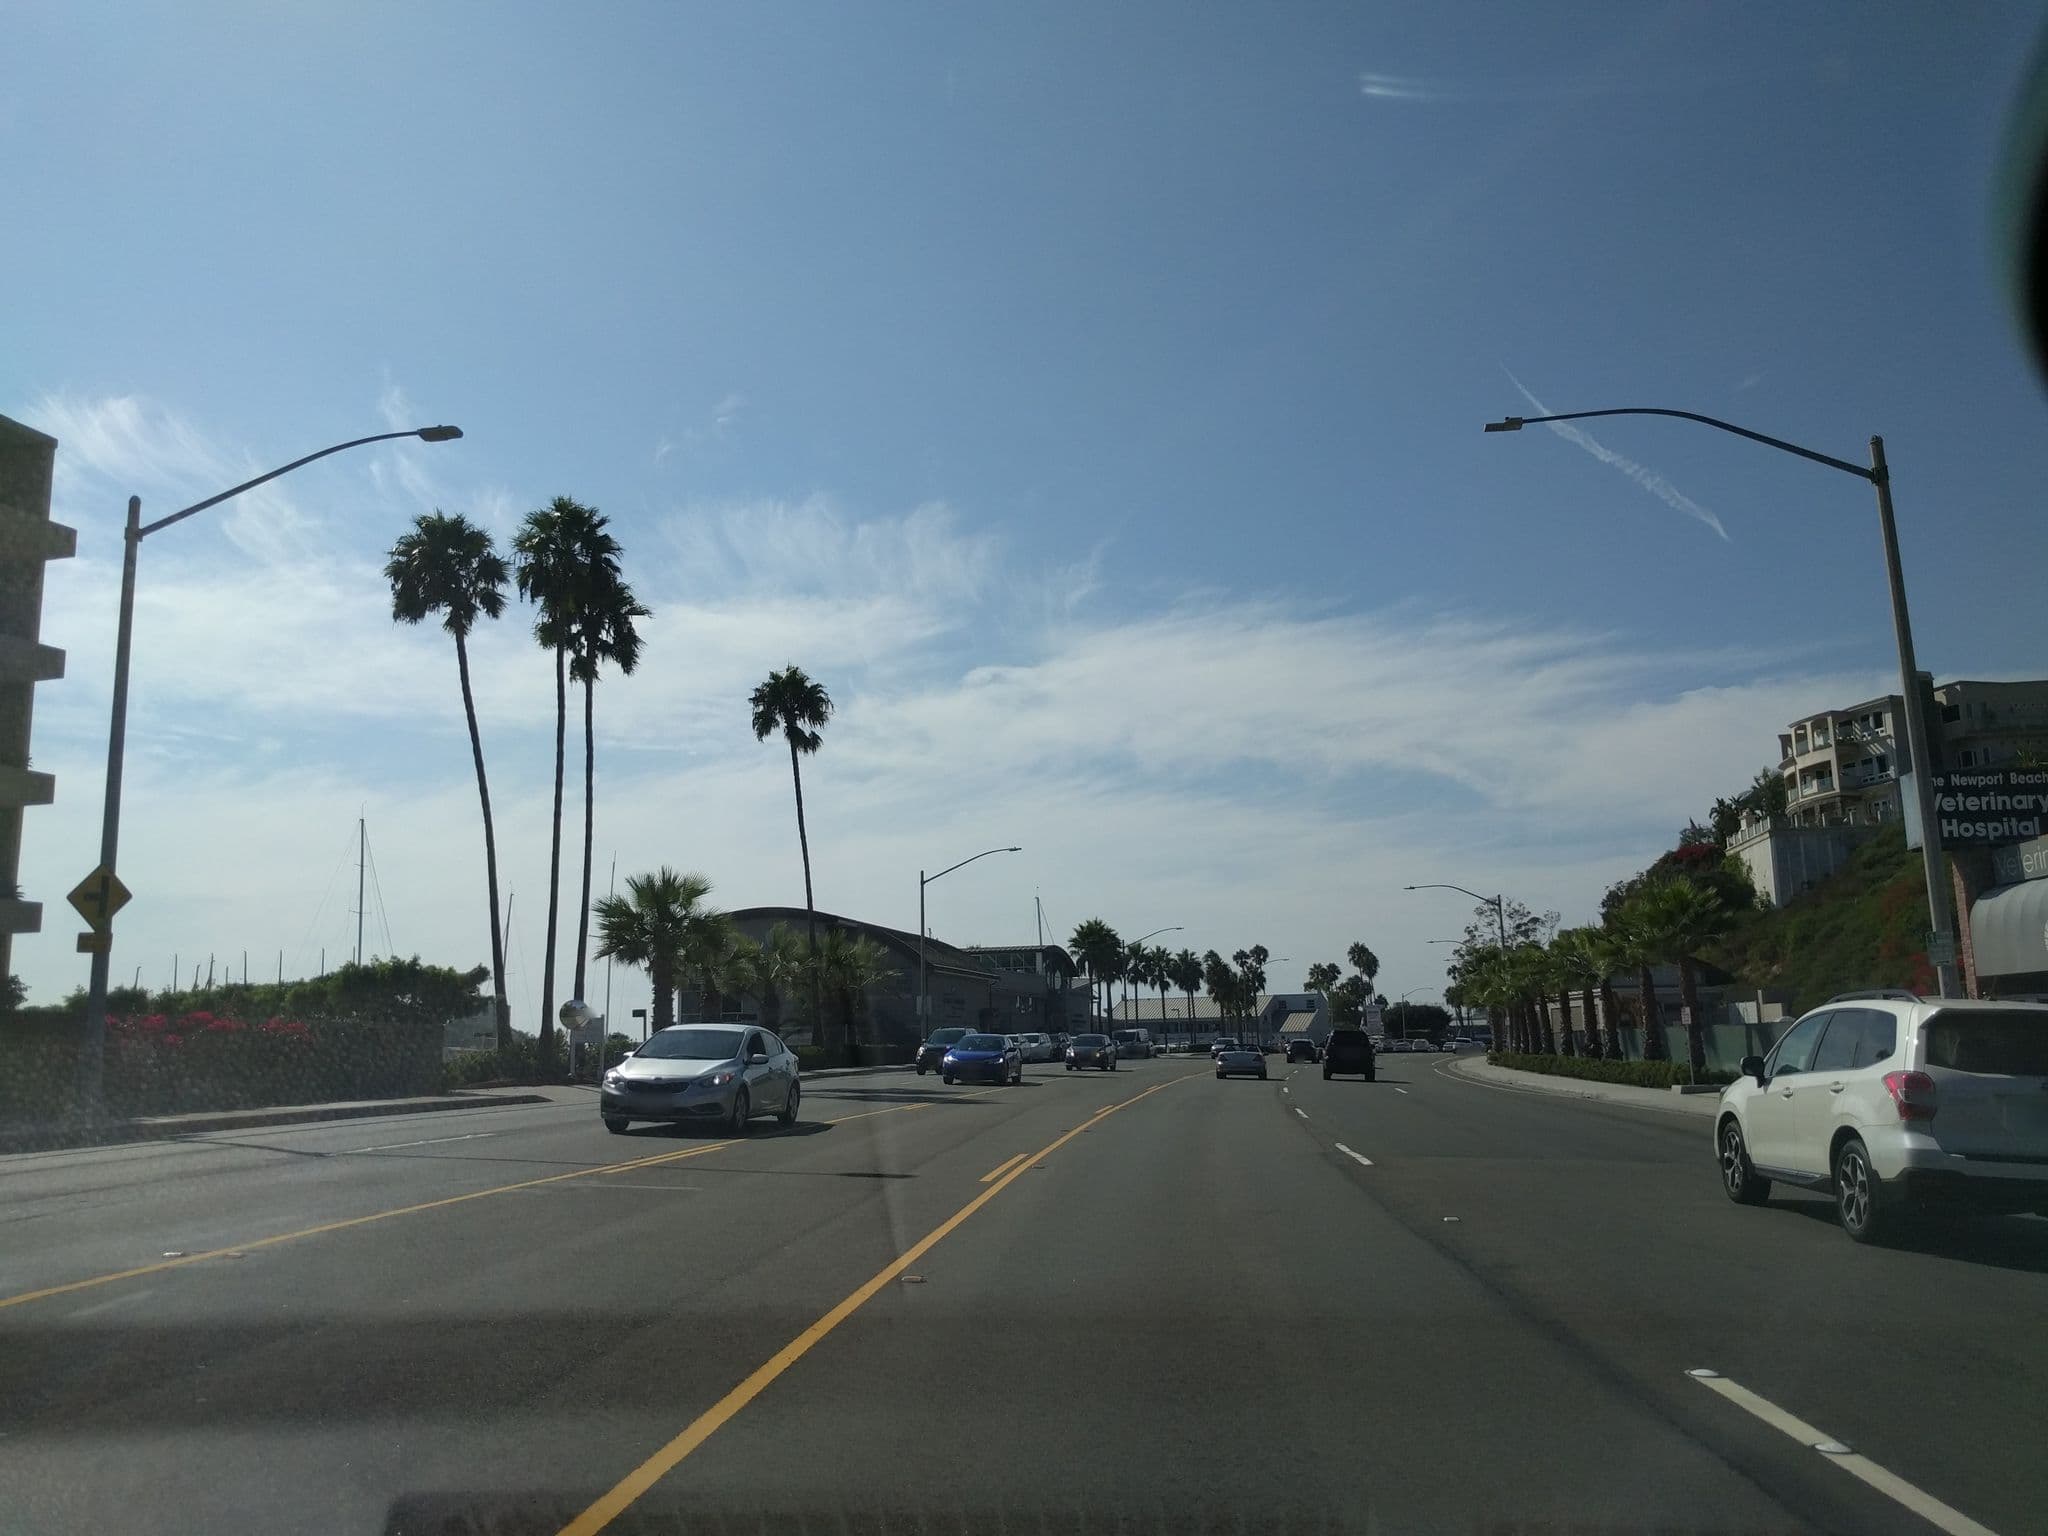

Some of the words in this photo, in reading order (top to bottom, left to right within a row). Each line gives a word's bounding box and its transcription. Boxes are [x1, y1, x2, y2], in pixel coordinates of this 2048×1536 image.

[1950, 774, 2003, 787] Newport
[2010, 772, 2048, 785] Beach
[1942, 816, 2040, 840] Hospital
